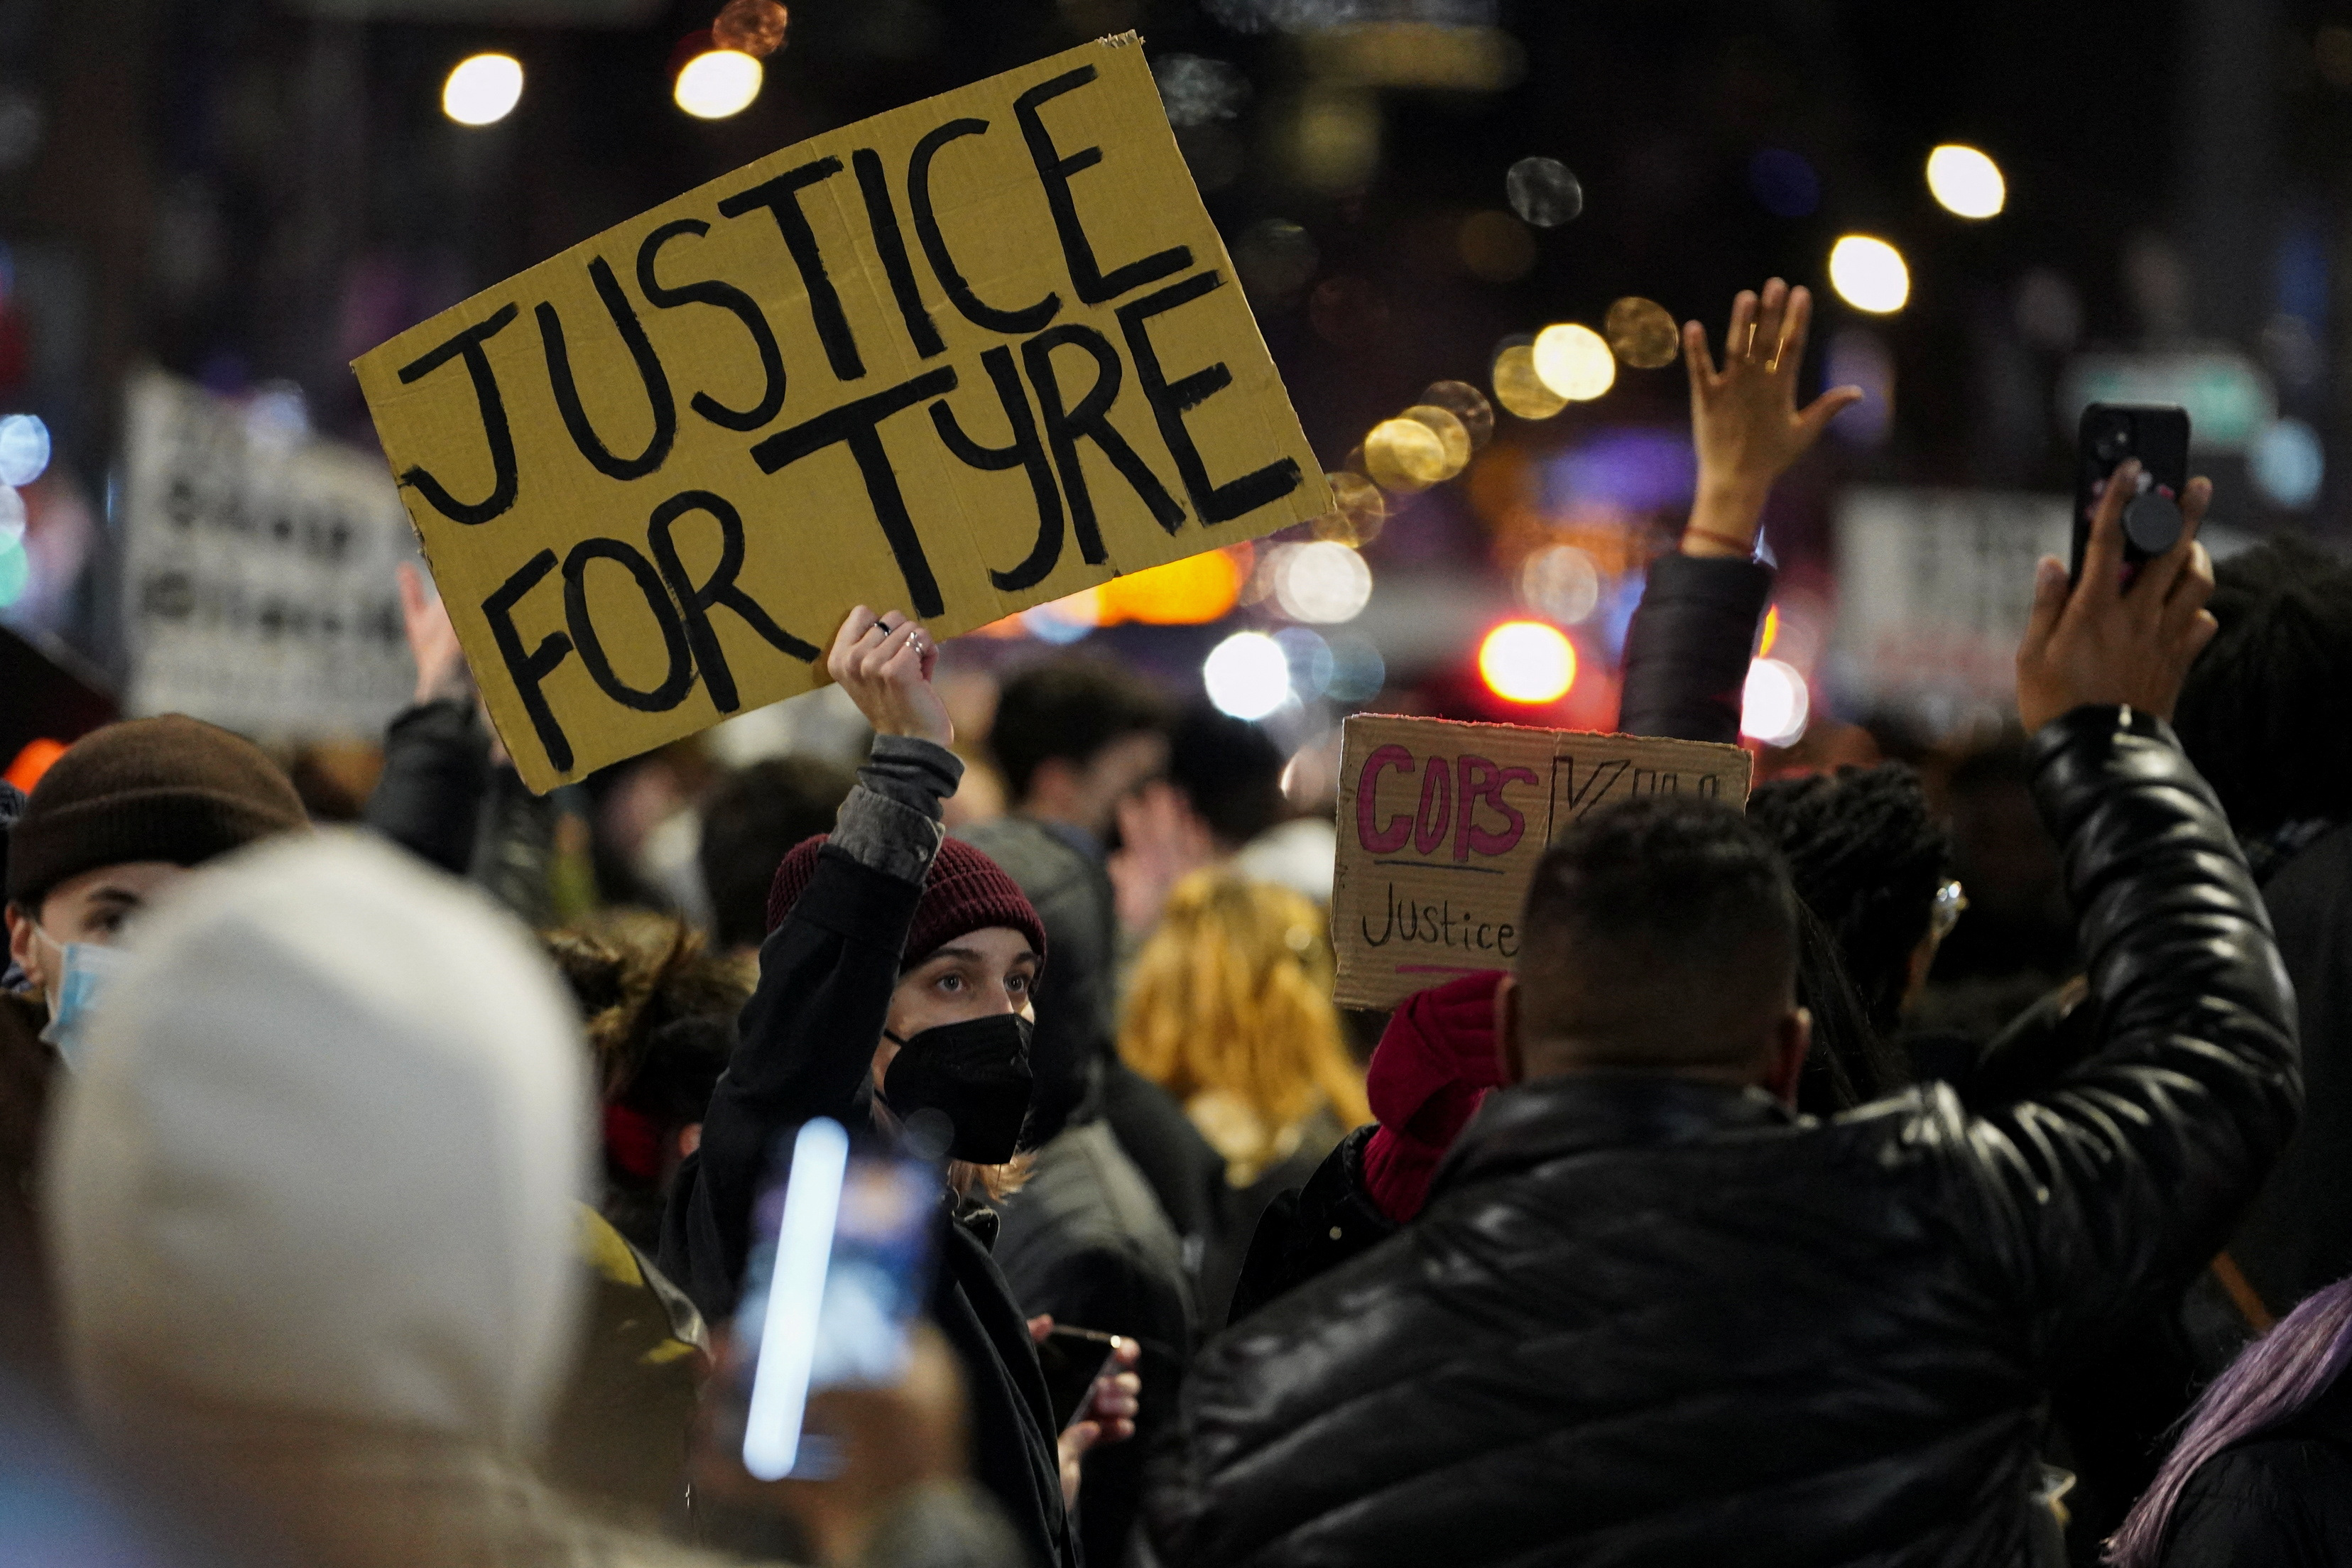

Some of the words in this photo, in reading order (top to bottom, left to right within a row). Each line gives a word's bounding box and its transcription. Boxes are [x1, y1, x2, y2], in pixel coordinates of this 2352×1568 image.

[400, 65, 1192, 524] JUSTICE
[481, 489, 820, 772] FOR
[751, 271, 1302, 618] TYRE
[1356, 745, 1540, 862] COPS
